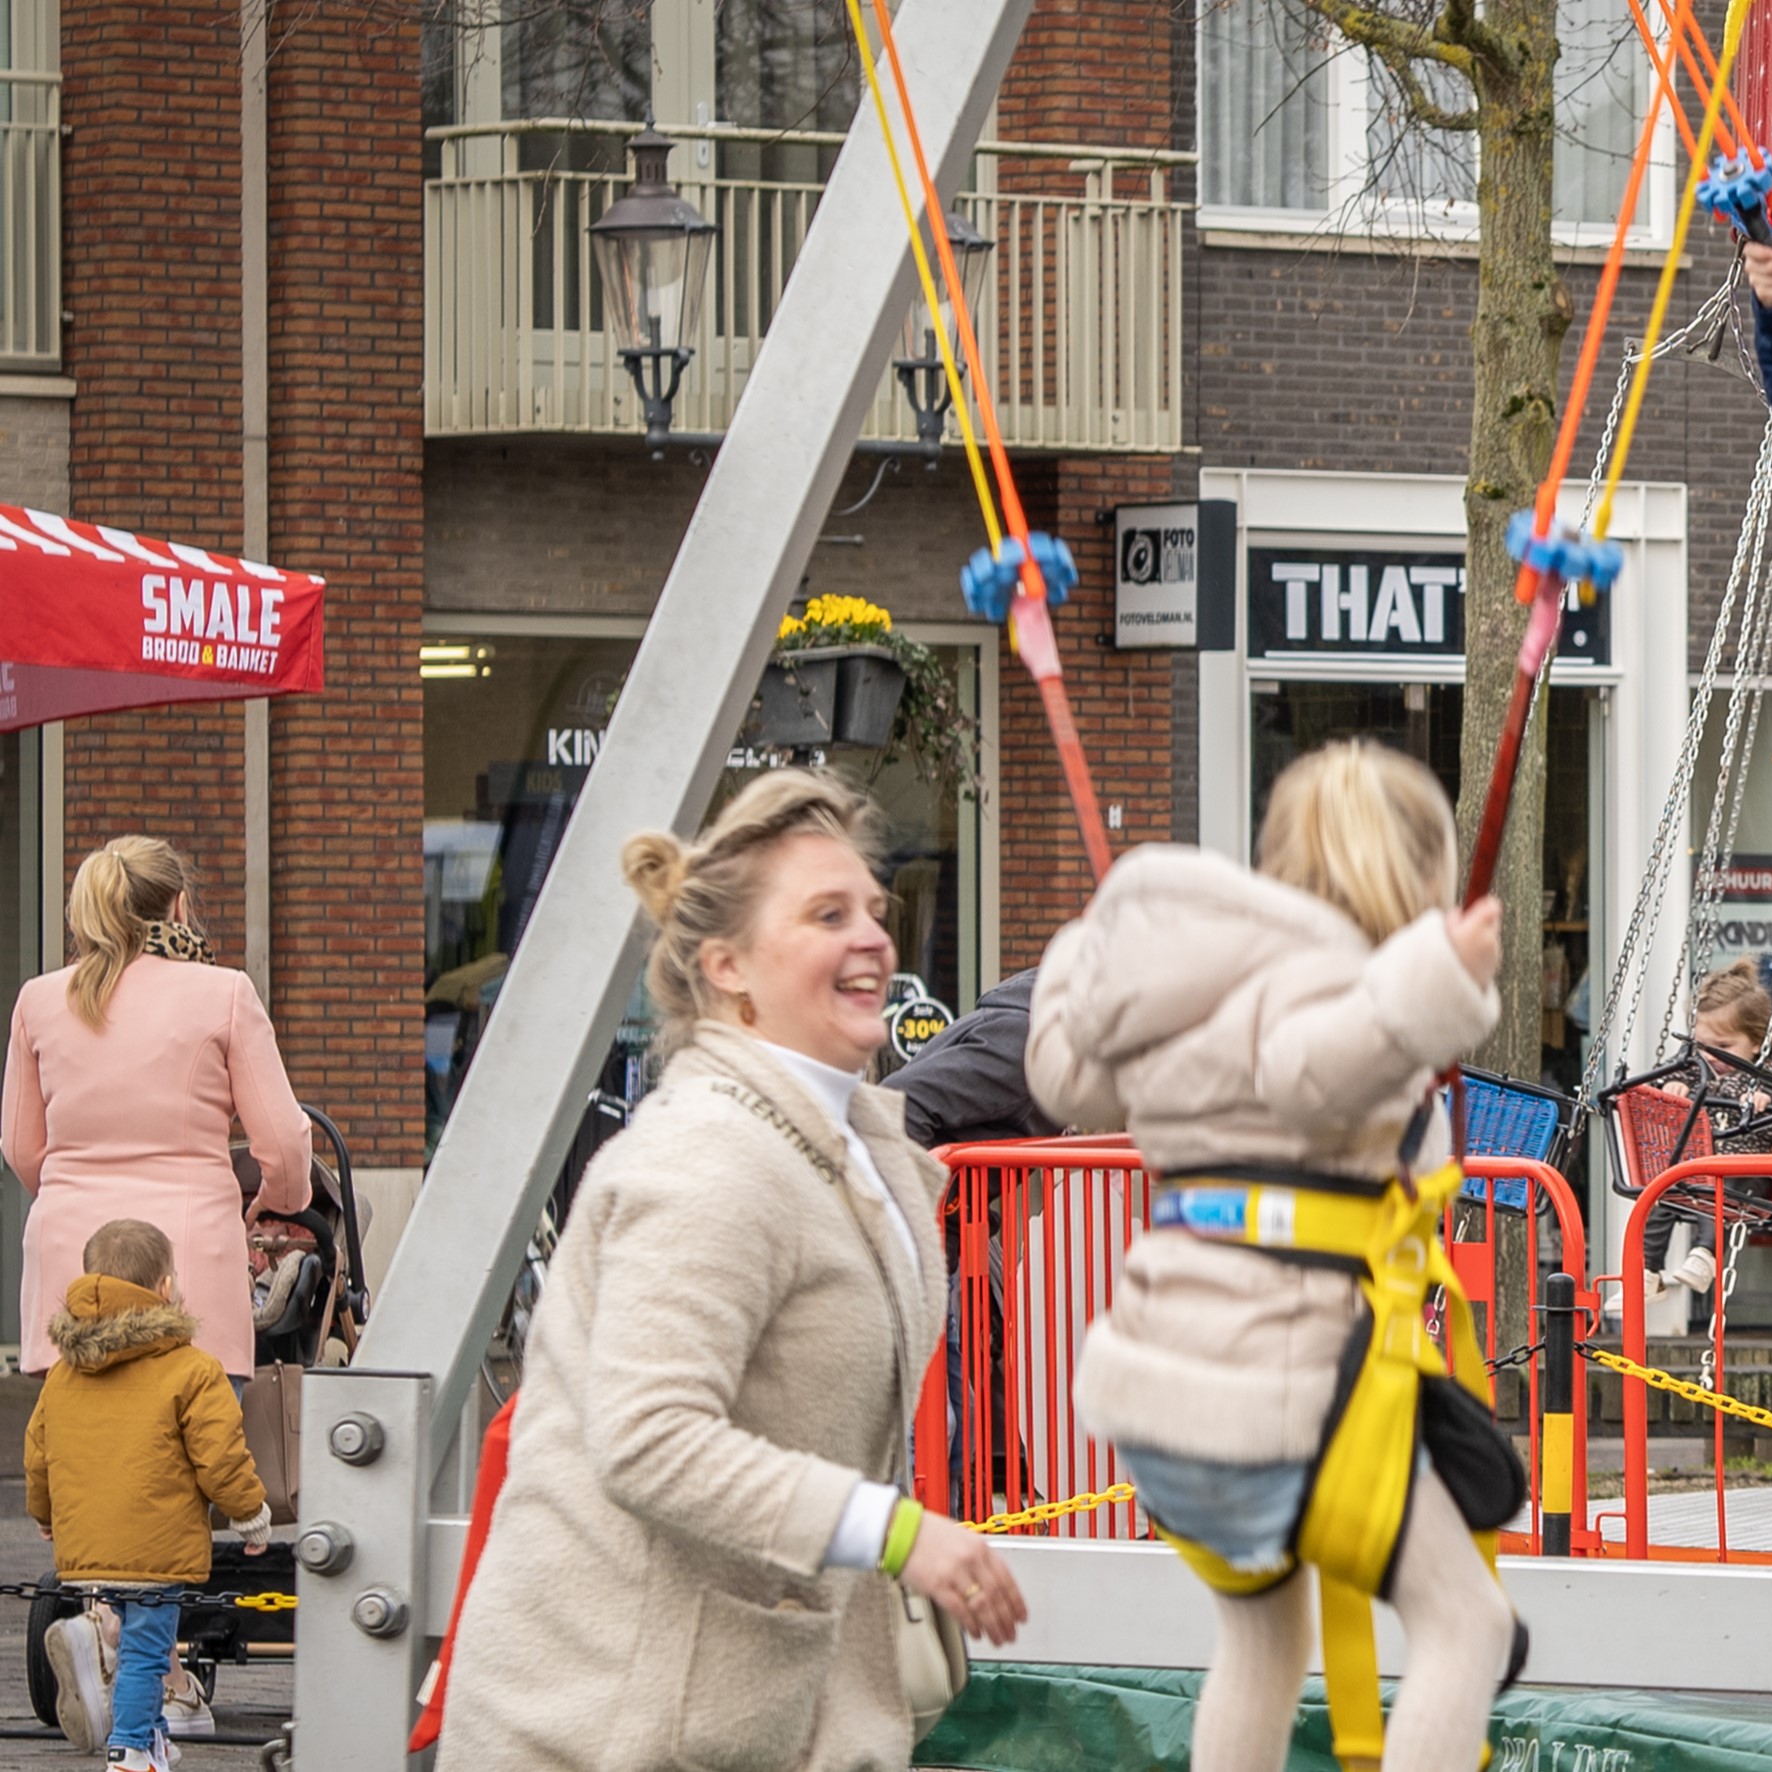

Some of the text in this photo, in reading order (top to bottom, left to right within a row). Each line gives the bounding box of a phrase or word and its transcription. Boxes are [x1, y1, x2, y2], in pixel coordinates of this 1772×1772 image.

[1163, 528, 1195, 548] FOTO
[142, 573, 285, 648] SMALE
[1119, 611, 1193, 626] FOTOVELDMAN.NL
[142, 635, 279, 675] BROOD & BANKET
